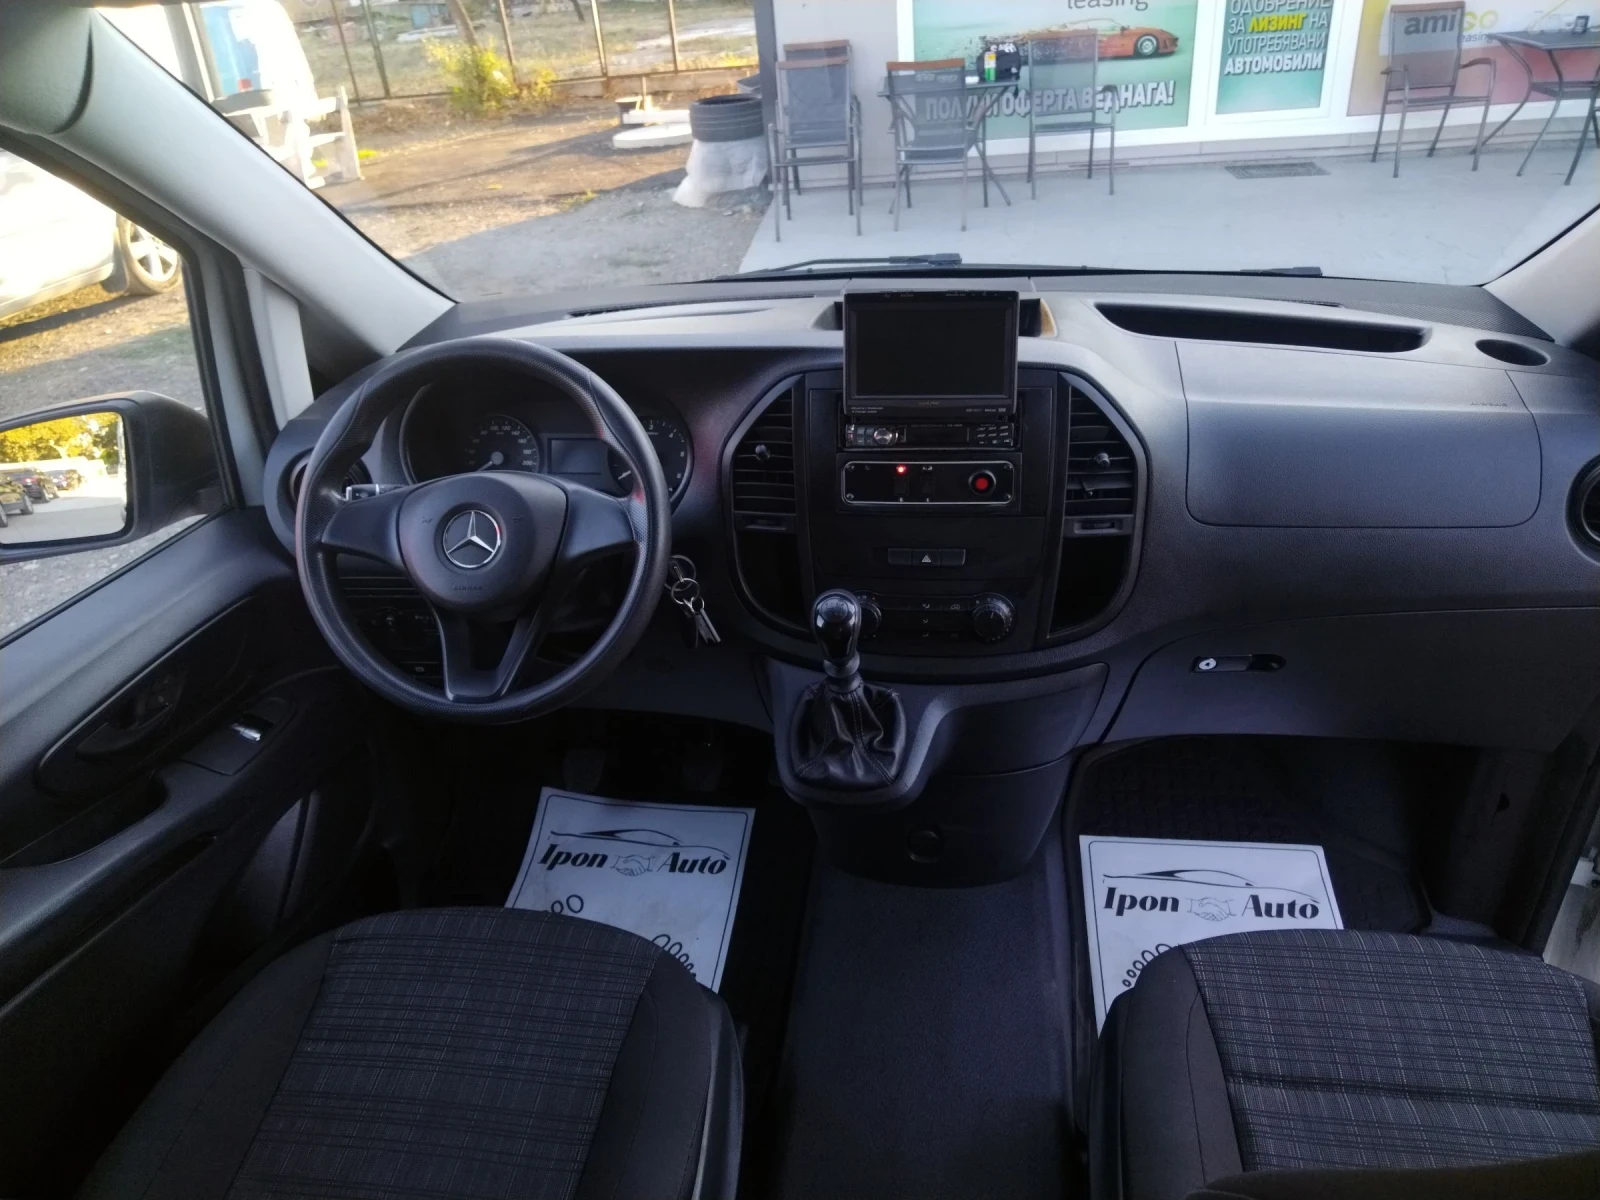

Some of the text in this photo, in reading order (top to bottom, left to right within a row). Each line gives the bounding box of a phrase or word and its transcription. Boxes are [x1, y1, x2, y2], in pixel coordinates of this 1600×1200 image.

[1228, 11, 1328, 35] ЗА ЛИЗИНГ НА
[1227, 32, 1327, 55] УПОТРЕБЯВАНИ
[1224, 52, 1323, 75] АВТОМОБИЛИ
[1002, 87, 1078, 117] ОФЕРТА
[538, 844, 727, 875] Ipon Auto
[1104, 887, 1320, 919] Ipon Auto
